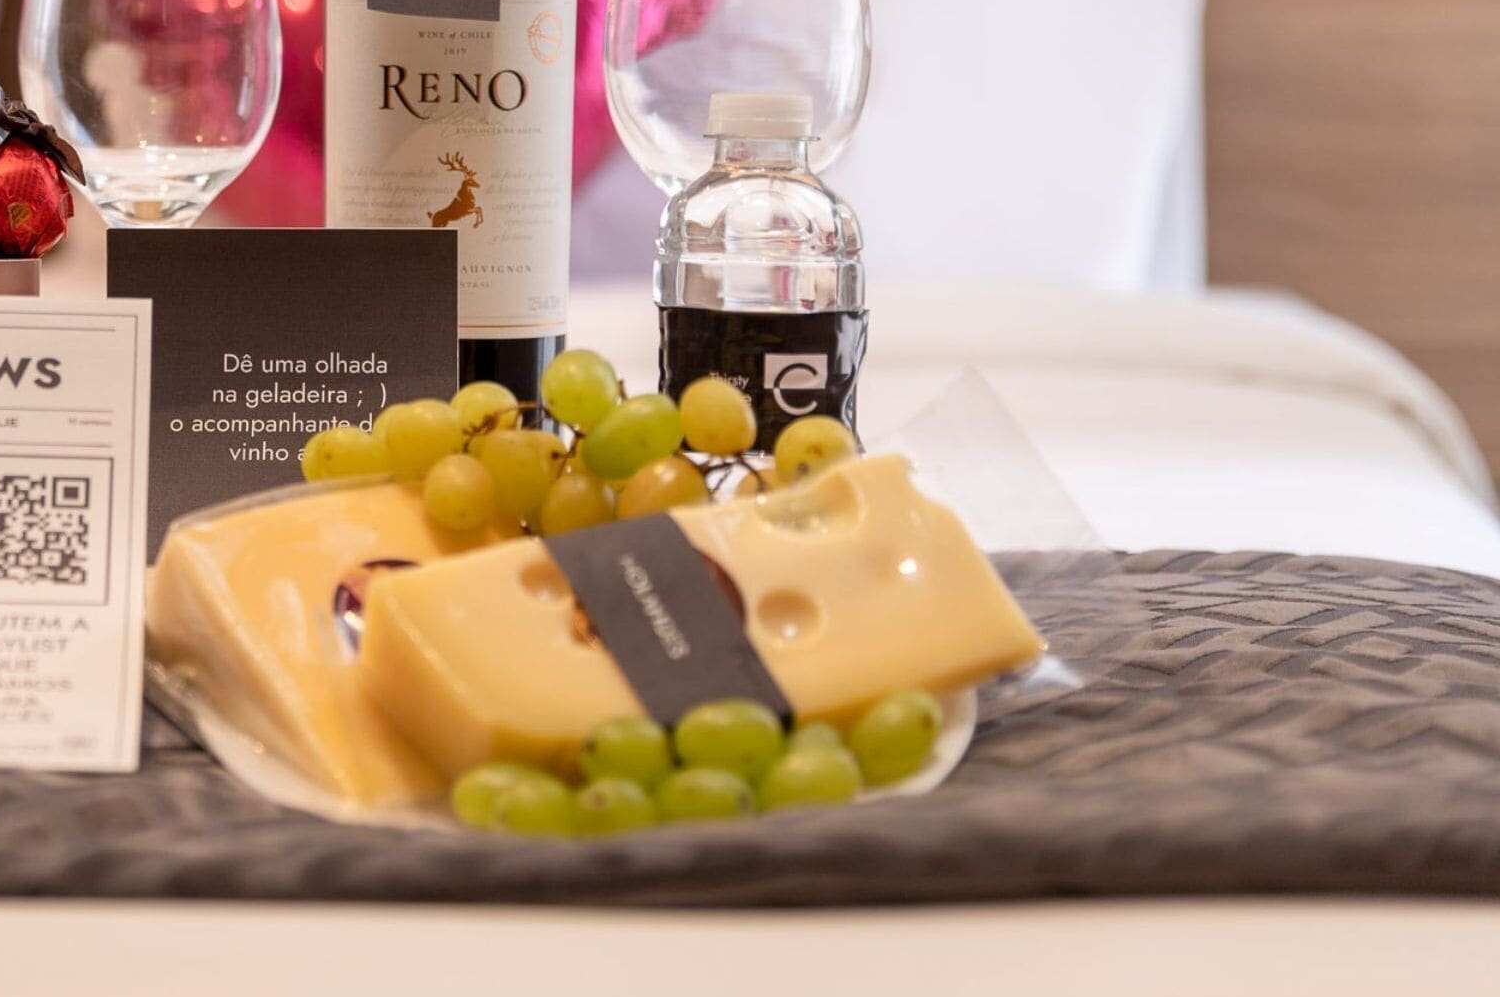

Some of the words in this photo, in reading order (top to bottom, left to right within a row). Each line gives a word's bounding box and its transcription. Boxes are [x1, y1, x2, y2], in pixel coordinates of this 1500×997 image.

[419, 31, 445, 39] WINE
[460, 31, 493, 40] CHILE
[378, 64, 528, 120] RENO
[460, 264, 532, 274] AUVIGNON
[223, 353, 253, 373] Dê
[261, 359, 307, 373] uma
[315, 352, 388, 374] olhada
[213, 389, 237, 403] na
[245, 382, 348, 409] geladeira
[170, 418, 184, 432] o
[229, 441, 289, 461] vinho
[72, 616, 90, 631] A
